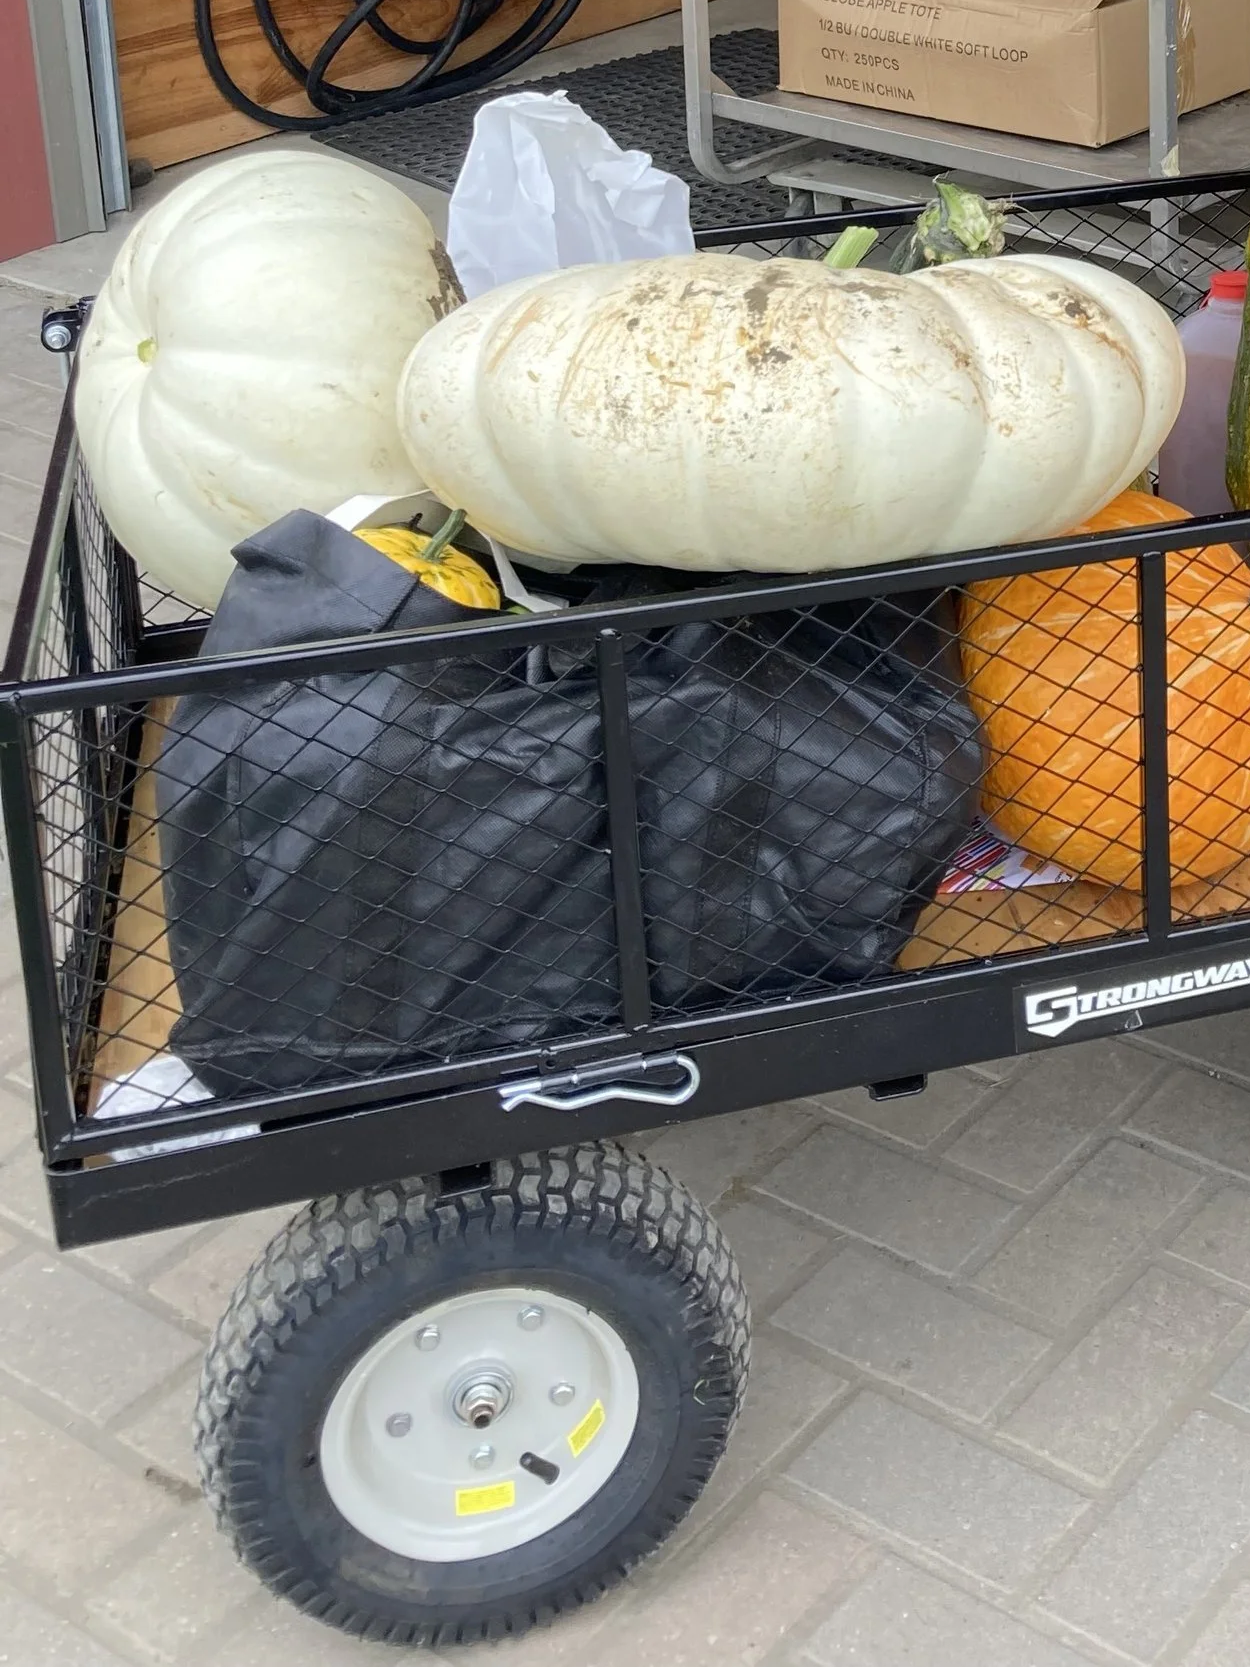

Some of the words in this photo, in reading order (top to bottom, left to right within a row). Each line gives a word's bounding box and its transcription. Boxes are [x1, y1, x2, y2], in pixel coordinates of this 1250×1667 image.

[910, 4, 942, 21] TOTE
[818, 18, 833, 34] 1/2
[836, 21, 852, 36] BU
[861, 26, 911, 47] DOUBLE
[913, 34, 954, 54] WHITE
[955, 41, 992, 60] SOFT
[992, 45, 1029, 64] LOOP
[821, 47, 849, 63] QTY:
[854, 52, 901, 72] 250PCS
[825, 74, 860, 93] MADE
[862, 81, 876, 95] IN
[877, 84, 916, 102] CHINA
